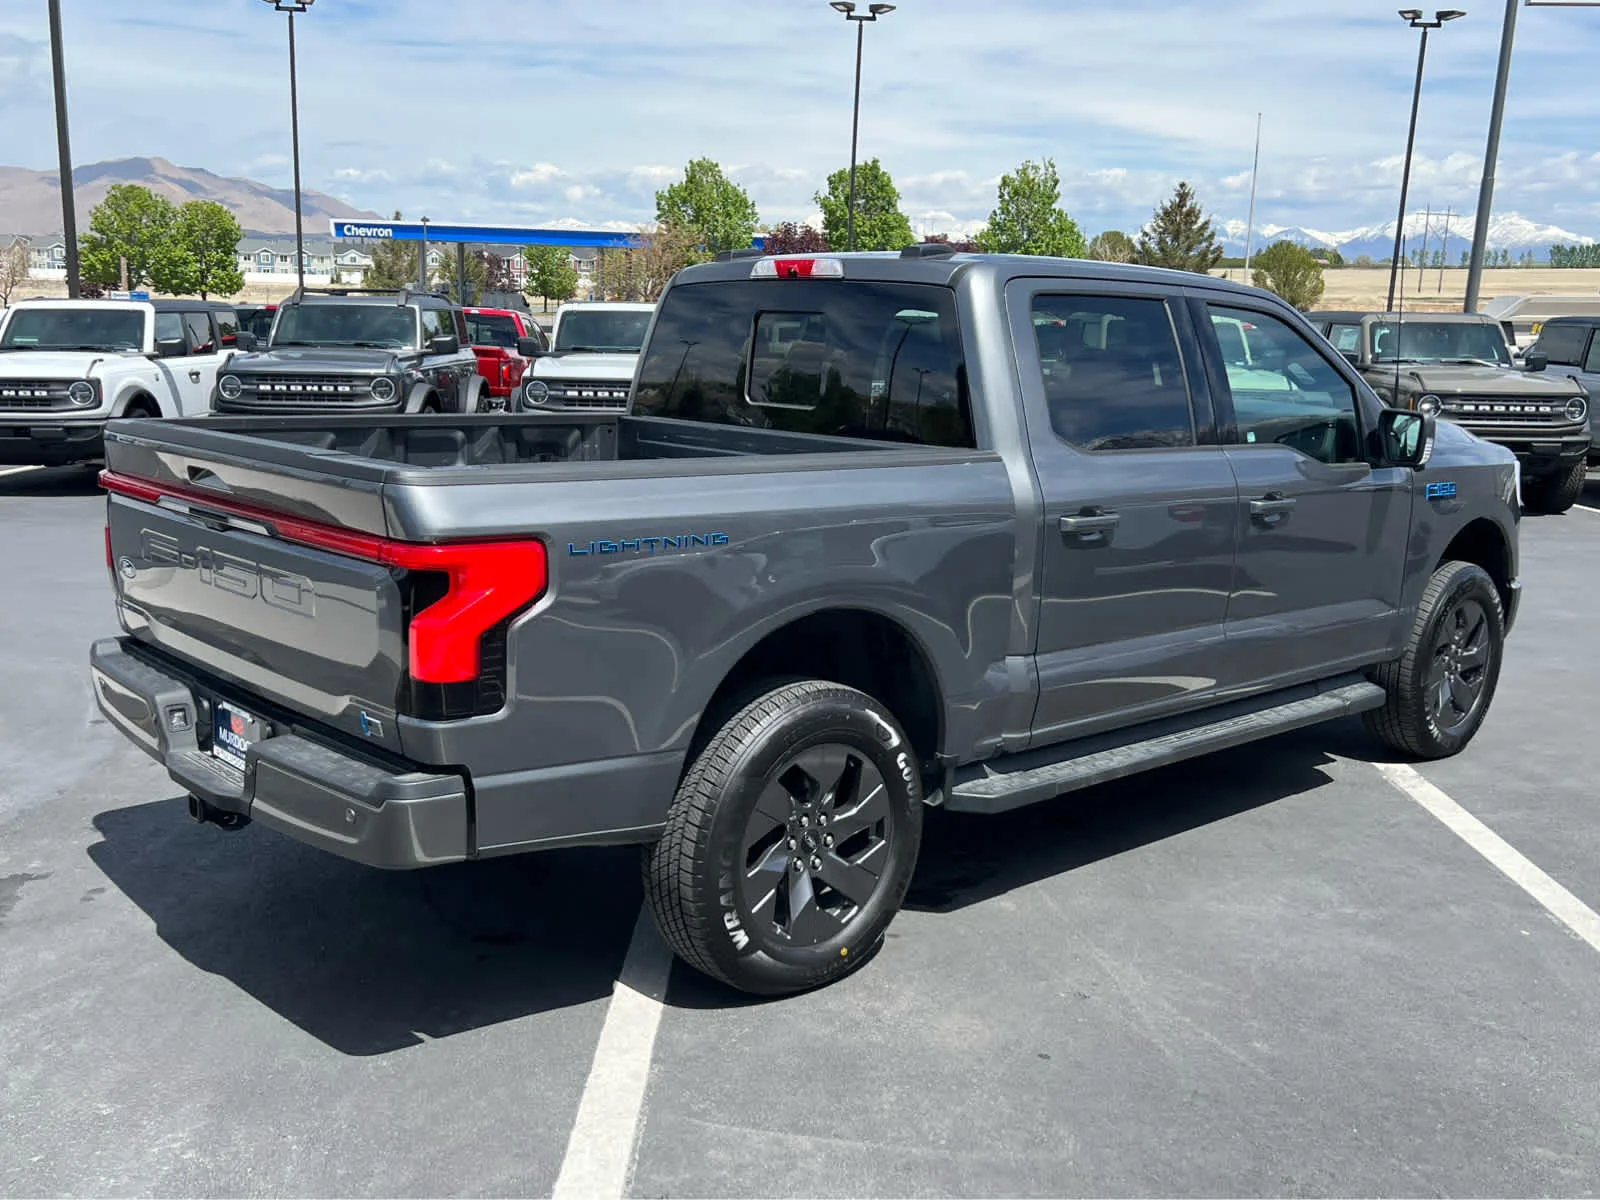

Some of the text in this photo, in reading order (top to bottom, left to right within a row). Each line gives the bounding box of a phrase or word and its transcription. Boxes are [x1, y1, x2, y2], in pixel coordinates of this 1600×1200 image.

[343, 224, 393, 237] Chevron
[259, 384, 351, 392] BRONCO
[1463, 404, 1552, 413] BRONCO
[567, 531, 729, 556] LIGHTNING
